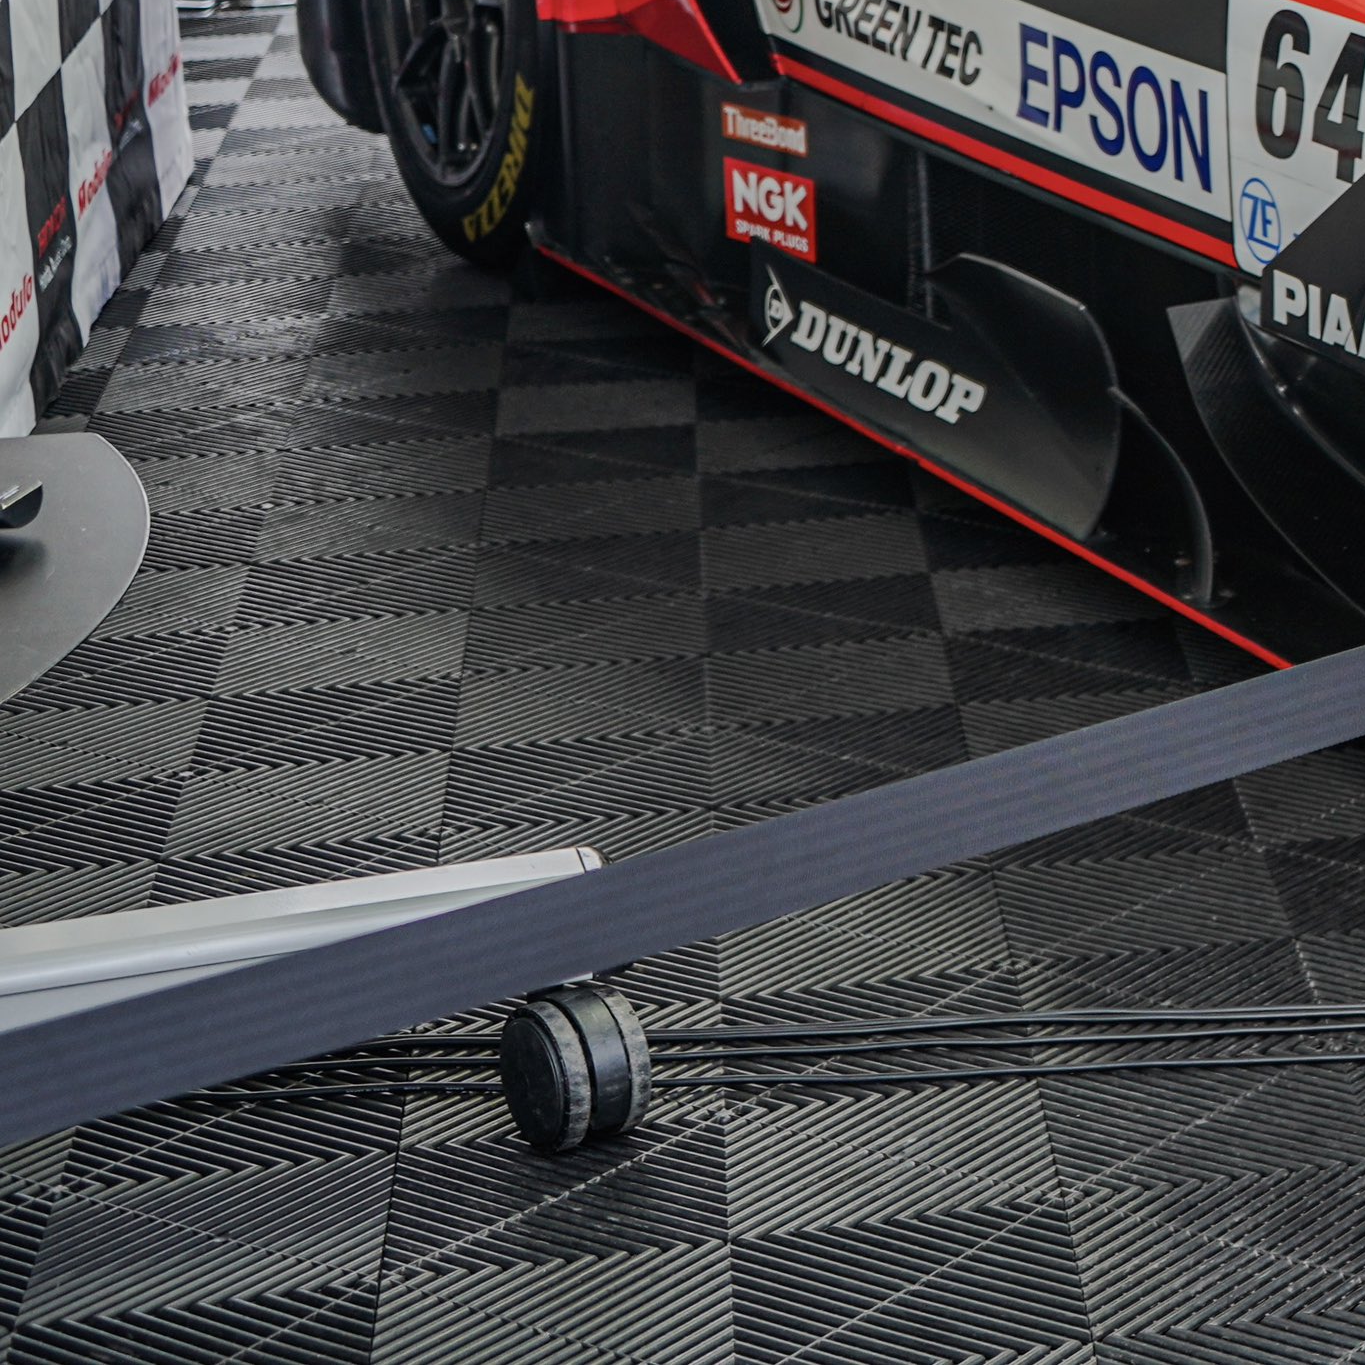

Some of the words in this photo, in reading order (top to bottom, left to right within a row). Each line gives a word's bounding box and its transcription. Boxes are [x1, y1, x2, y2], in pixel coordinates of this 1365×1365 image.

[923, 5, 984, 88] TEC
[723, 105, 806, 154] ThreeBond
[1016, 22, 1213, 194] EPSON
[732, 168, 808, 232] NGK
[735, 218, 771, 243] SPARK
[772, 230, 809, 254] PLUGS
[1242, 182, 1281, 259] ZF
[0, 272, 33, 352] odulo
[790, 300, 986, 425] DUNLOP
